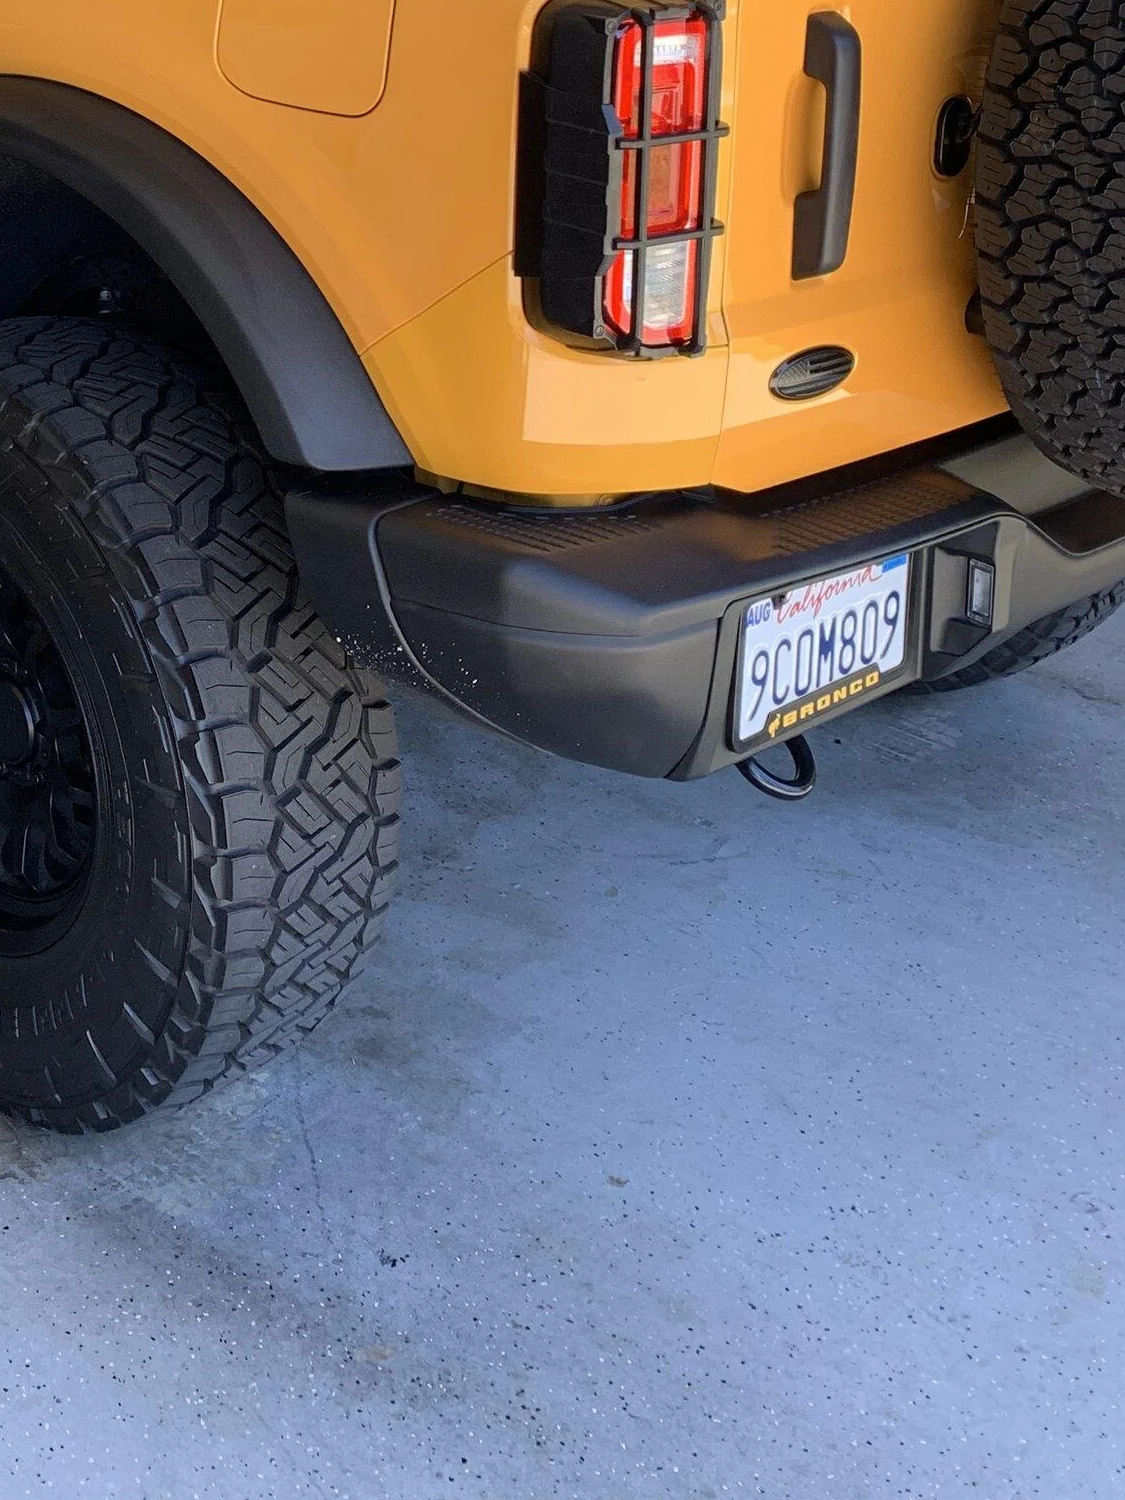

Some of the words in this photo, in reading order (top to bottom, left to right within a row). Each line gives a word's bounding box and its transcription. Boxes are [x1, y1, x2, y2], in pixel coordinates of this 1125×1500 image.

[746, 601, 771, 628] AUG
[748, 590, 900, 722] 9COM809
[782, 670, 879, 727] BRONCO
